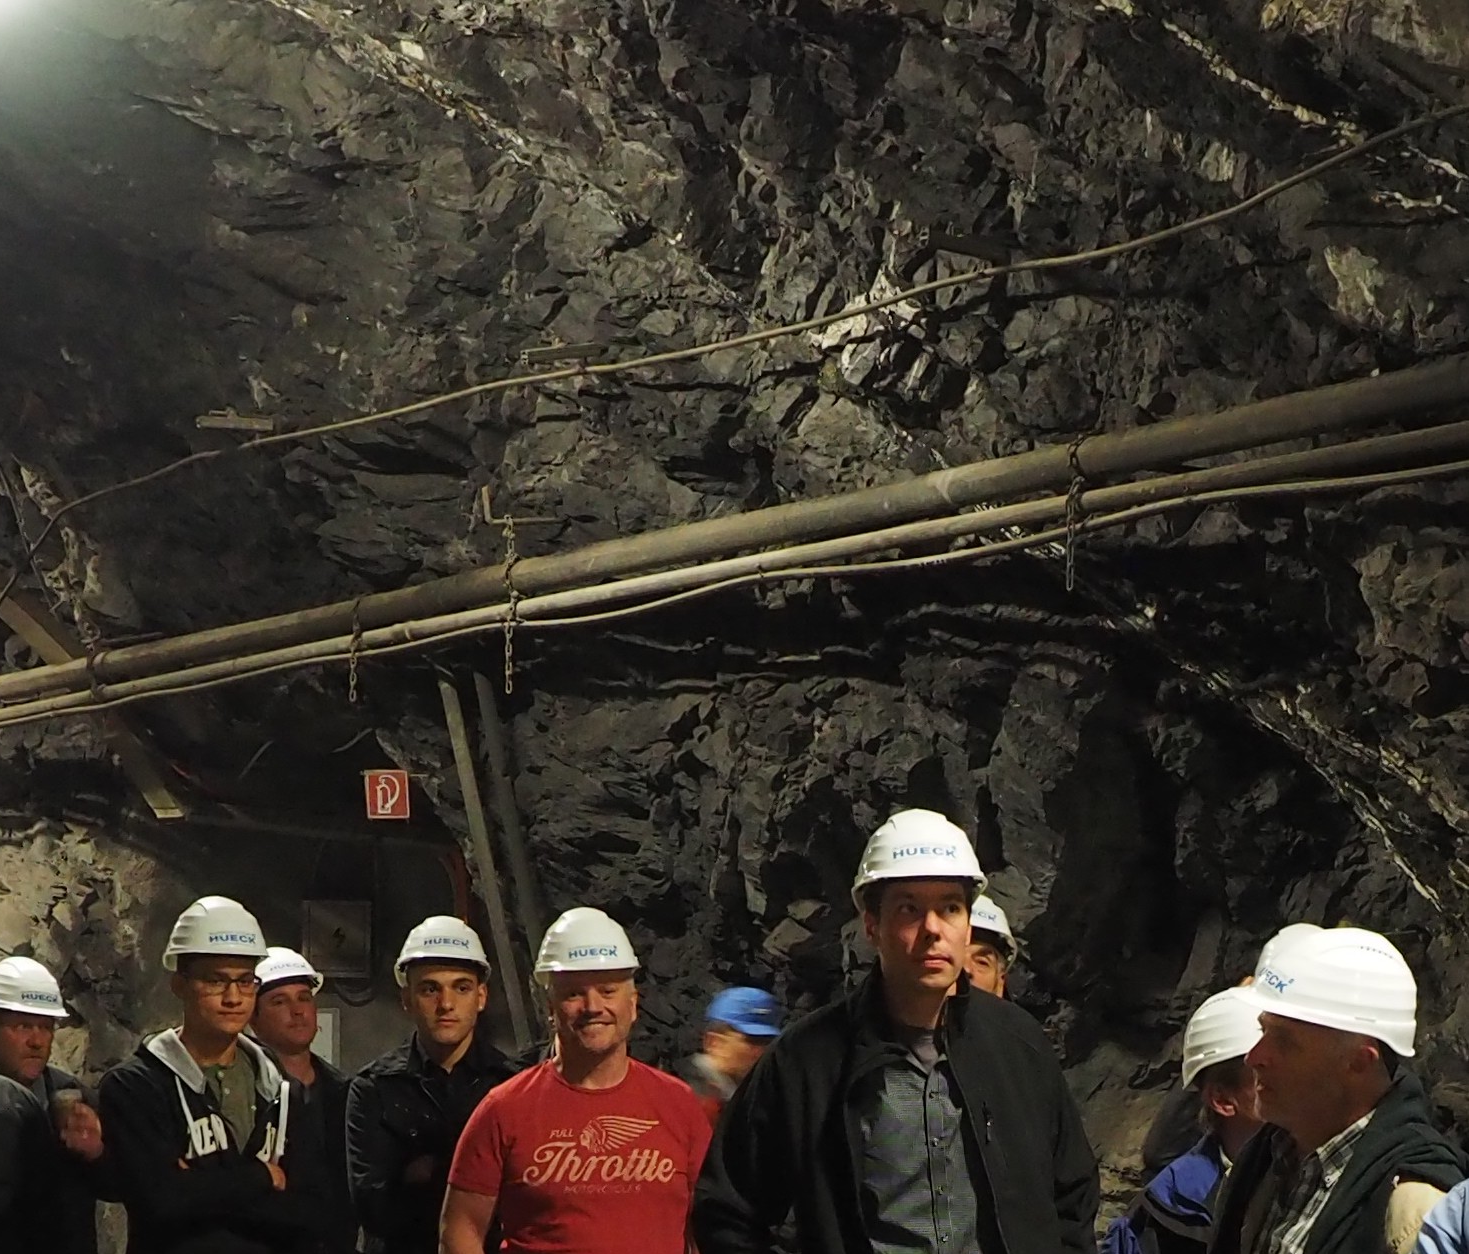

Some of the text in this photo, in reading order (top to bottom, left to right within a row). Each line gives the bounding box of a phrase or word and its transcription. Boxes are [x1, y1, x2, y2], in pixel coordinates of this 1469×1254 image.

[892, 846, 957, 859] HUECK
[209, 934, 256, 944] HUECK
[423, 938, 469, 949] HUECK
[568, 947, 618, 959] HUECK
[21, 992, 58, 1002] HUECK
[549, 1128, 575, 1140] FULL
[522, 1141, 677, 1187] Throttle
